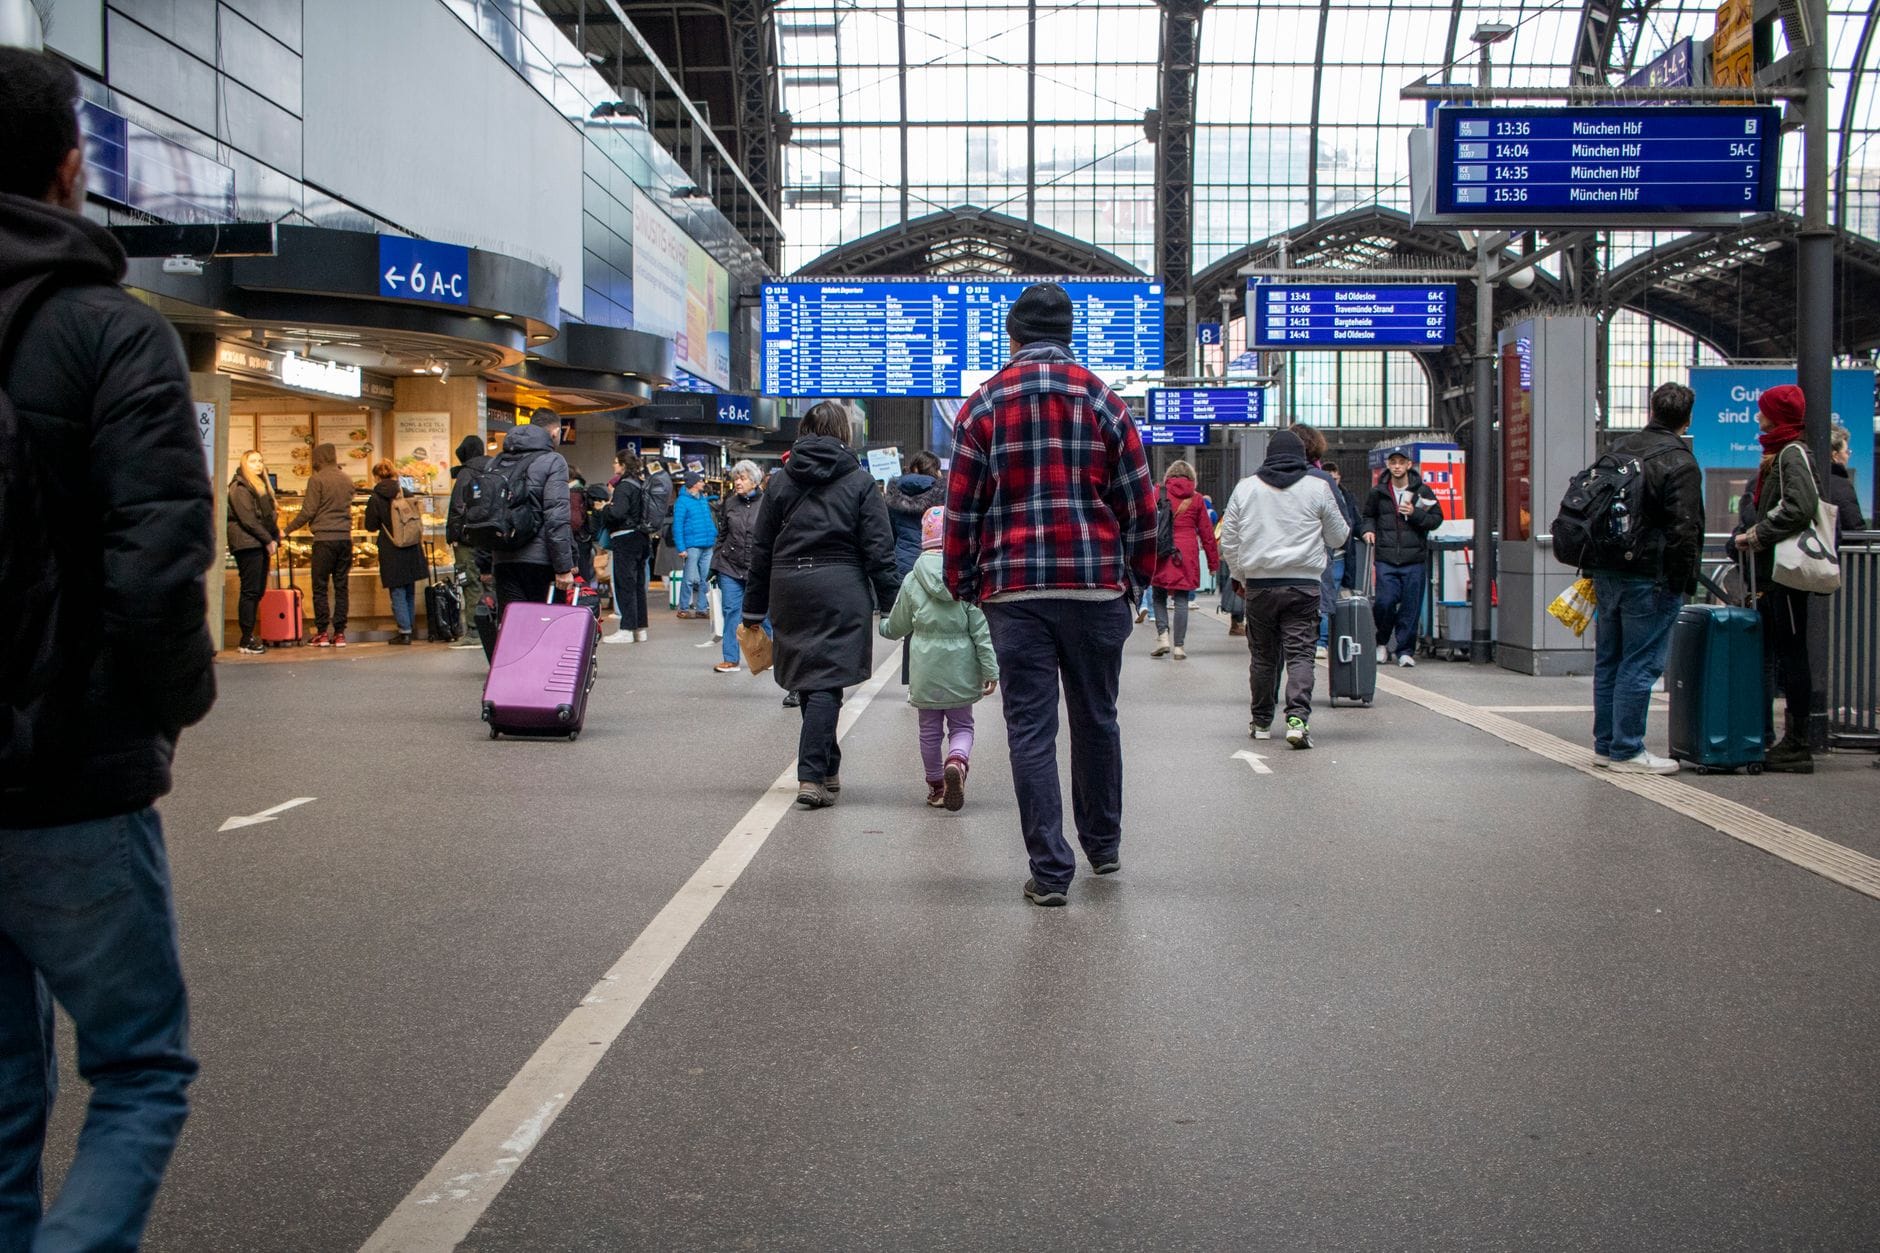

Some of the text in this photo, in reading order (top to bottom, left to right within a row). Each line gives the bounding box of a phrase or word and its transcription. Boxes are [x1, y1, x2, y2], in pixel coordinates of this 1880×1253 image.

[1496, 121, 1754, 134] 13:36 München Hbf 5
[1496, 144, 1755, 157] 14:04 München Hbf 5A-C
[1495, 166, 1753, 179] 14:35 München Hbf 5
[1494, 188, 1751, 201] 15:36 München Hbf 5
[410, 262, 462, 298] 6 A-C
[1068, 276, 1154, 284] Hamburg
[1335, 305, 1372, 313] Travemünde
[1373, 305, 1394, 313] Strand
[1334, 318, 1372, 326] Bargteheide
[1202, 329, 1212, 343] 8
[200, 412, 210, 425] &
[729, 405, 750, 420] 8 A-C
[1718, 408, 1749, 423] sind
[1730, 443, 1745, 451] Hier
